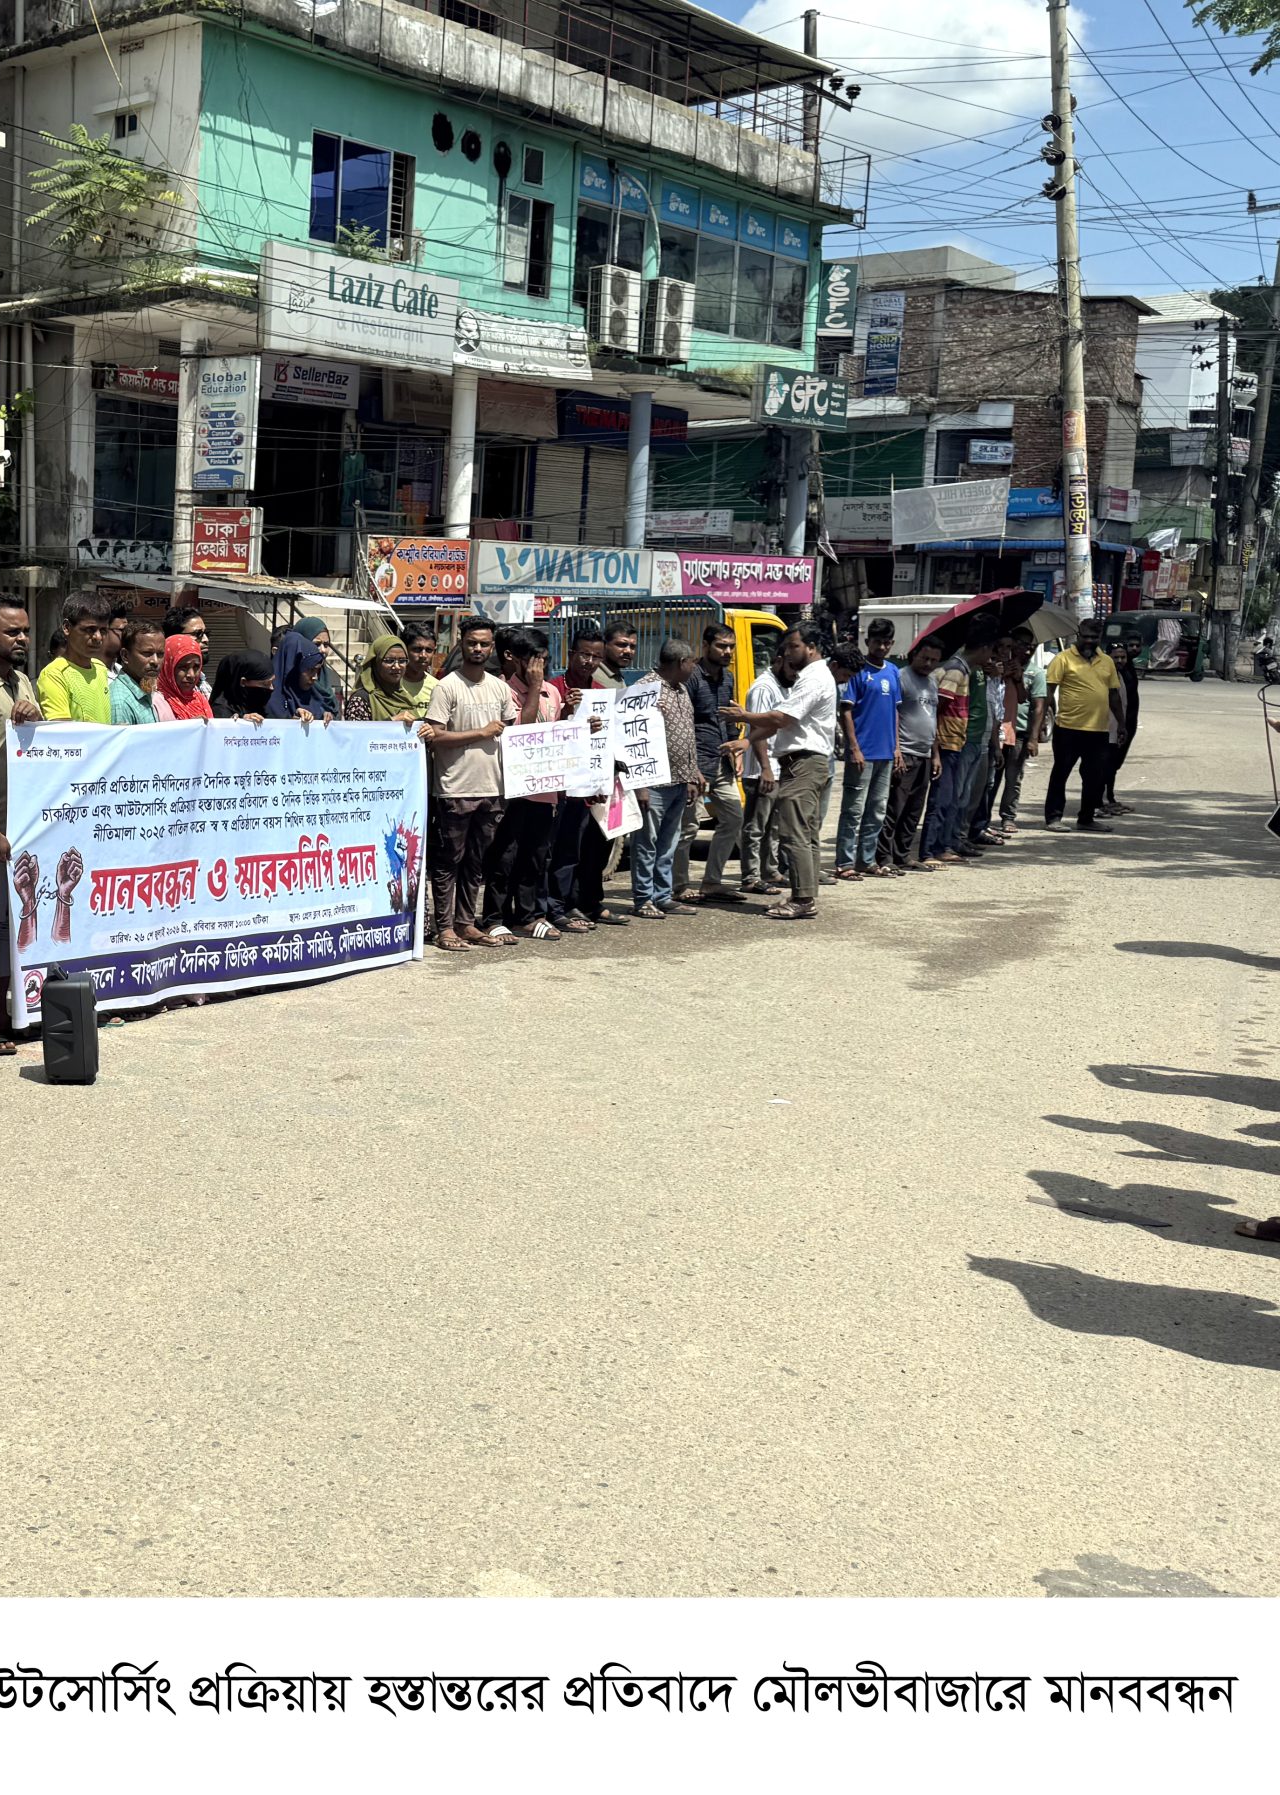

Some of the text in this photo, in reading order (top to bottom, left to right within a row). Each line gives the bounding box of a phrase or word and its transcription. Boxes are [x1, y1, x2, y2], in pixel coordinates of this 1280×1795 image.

[328, 265, 439, 319] Laziz Cafe
[336, 309, 424, 343] & Restaurant
[201, 384, 247, 394] Education
[202, 371, 247, 383] Global
[293, 366, 349, 386] SellerBaz
[790, 375, 829, 416] GFC
[204, 522, 239, 538] ঢাকা
[196, 537, 249, 558] তেহারী ঘর
[533, 548, 640, 584] WALTON
[732, 561, 763, 589] ফুচকা
[784, 558, 812, 583] বার্গার
[508, 731, 546, 748] সরকার
[623, 714, 650, 737] দাবি
[70, 776, 108, 796] সরকারি
[109, 774, 150, 794] প্রতিষ্ঠানে
[151, 774, 190, 793] দীর্ঘদিনের
[204, 771, 231, 789] দৈনিক
[233, 771, 252, 791] মজুরি
[253, 770, 277, 788] ভিত্তিক
[280, 774, 286, 786] ও
[320, 768, 351, 785] কর্মচারীদের
[352, 768, 366, 784] বিনা
[367, 769, 388, 783] কারণে
[91, 805, 111, 819] এবং
[114, 797, 168, 817] আউটসোর্সিং
[198, 796, 238, 813] হস্তান্তরের
[238, 793, 269, 811] প্রতিবাদে
[272, 795, 279, 807] ও
[281, 791, 301, 807] দৈনিক
[342, 787, 360, 803] শ্রমিক
[92, 824, 138, 843] নীতিমালা
[139, 826, 166, 841] ২০২৫
[189, 820, 206, 834] করে
[231, 813, 261, 832] প্রতিষ্ঠানে
[262, 816, 282, 830] বয়স
[350, 809, 371, 824] দাবিতে
[90, 834, 378, 916] মানববন্ধন ও স্মারকলিপি প্রদান
[110, 932, 132, 944] তারিখ:
[134, 934, 145, 943] ২৬
[193, 919, 216, 932] রবিবার
[217, 920, 234, 931] সকাল
[252, 914, 269, 926] ঘটিকা
[130, 922, 410, 986] বাংলাদেশ দৈনিক ভিত্তিক কর্মচারী সমিতি, মৌলভীবাজার জেলা
